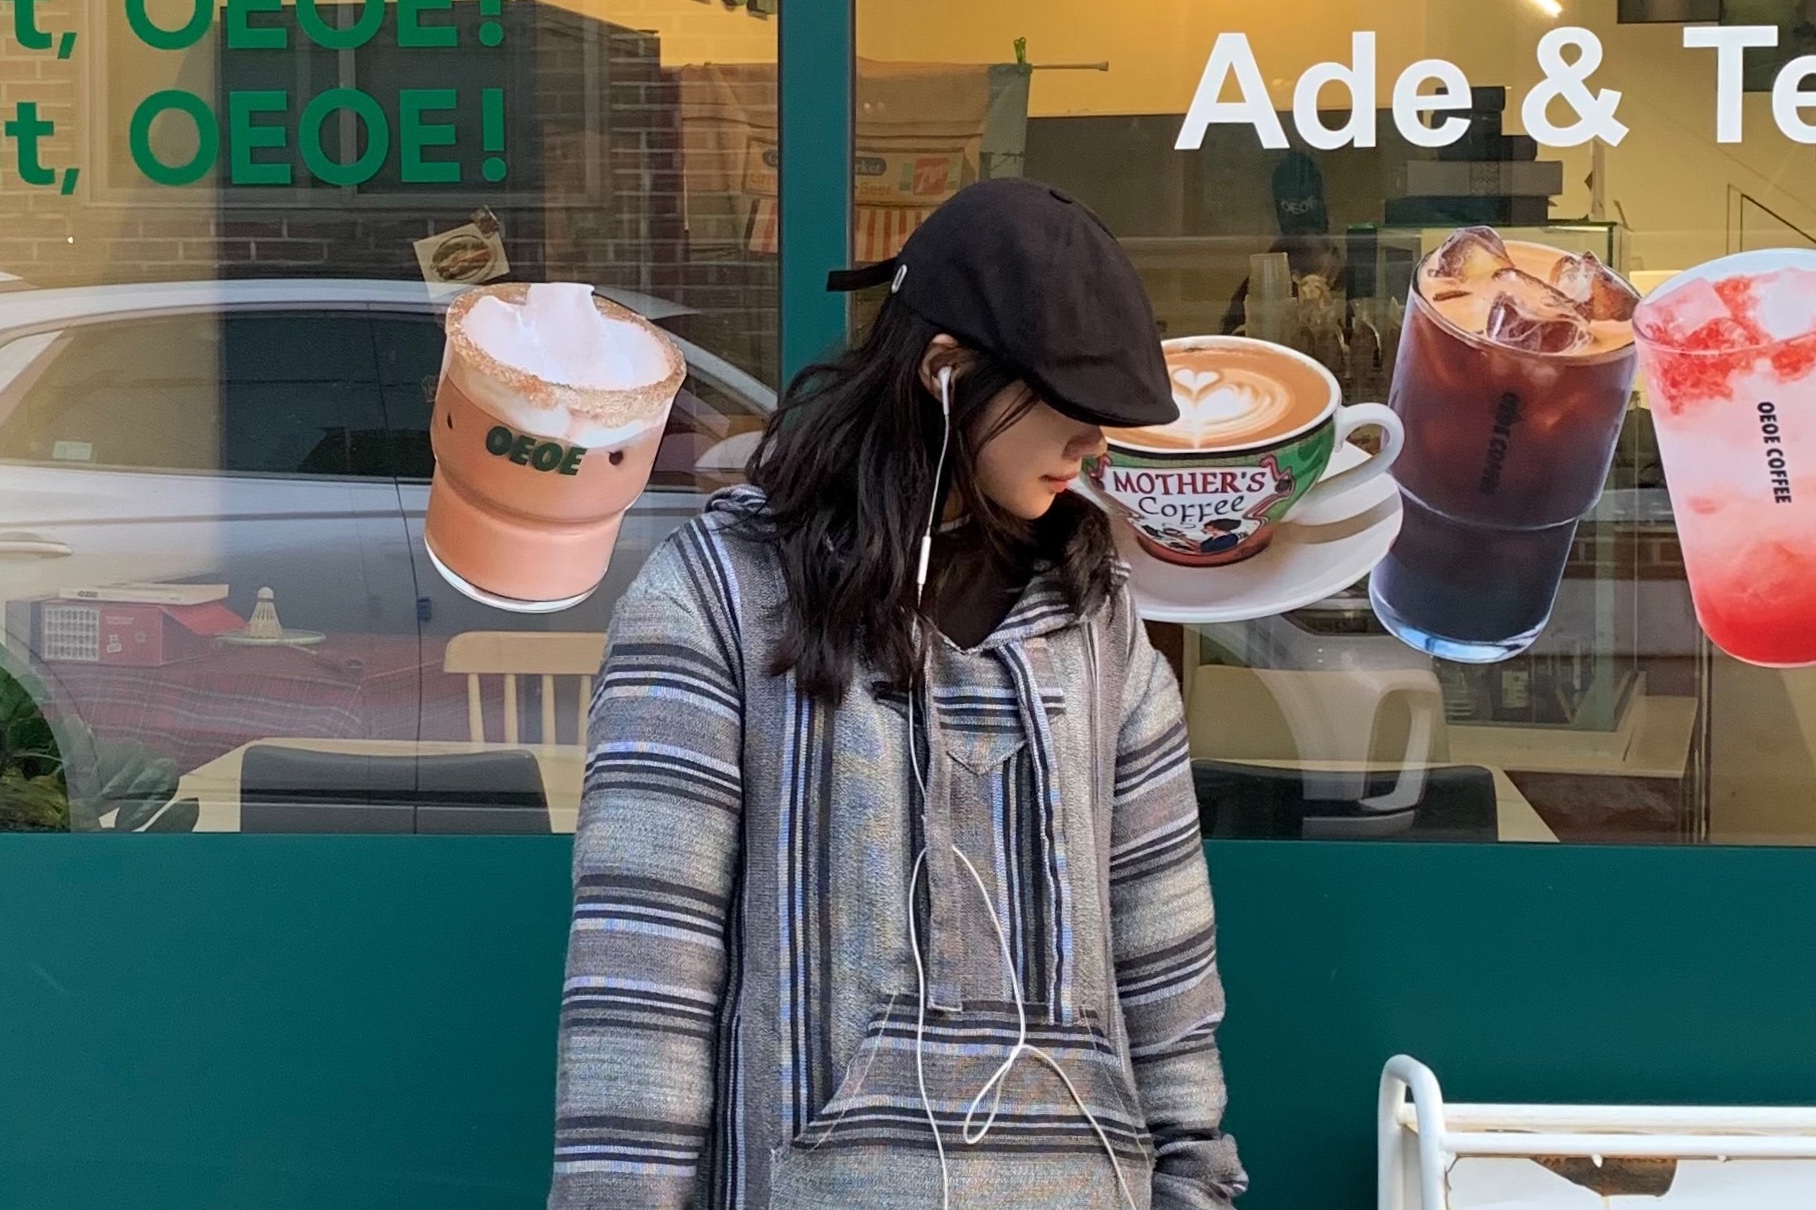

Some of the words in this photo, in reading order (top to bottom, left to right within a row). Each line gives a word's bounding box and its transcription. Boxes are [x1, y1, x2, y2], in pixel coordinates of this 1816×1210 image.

[1174, 30, 1474, 150] Ade
[1520, 26, 1630, 148] &
[129, 87, 507, 187] OEOE!
[1757, 401, 1781, 445] OEOE
[485, 425, 588, 476] OEOE
[1765, 447, 1792, 504] COFFEE
[1112, 470, 1267, 496] MOTHER'S
[1138, 495, 1245, 524] Coffee
